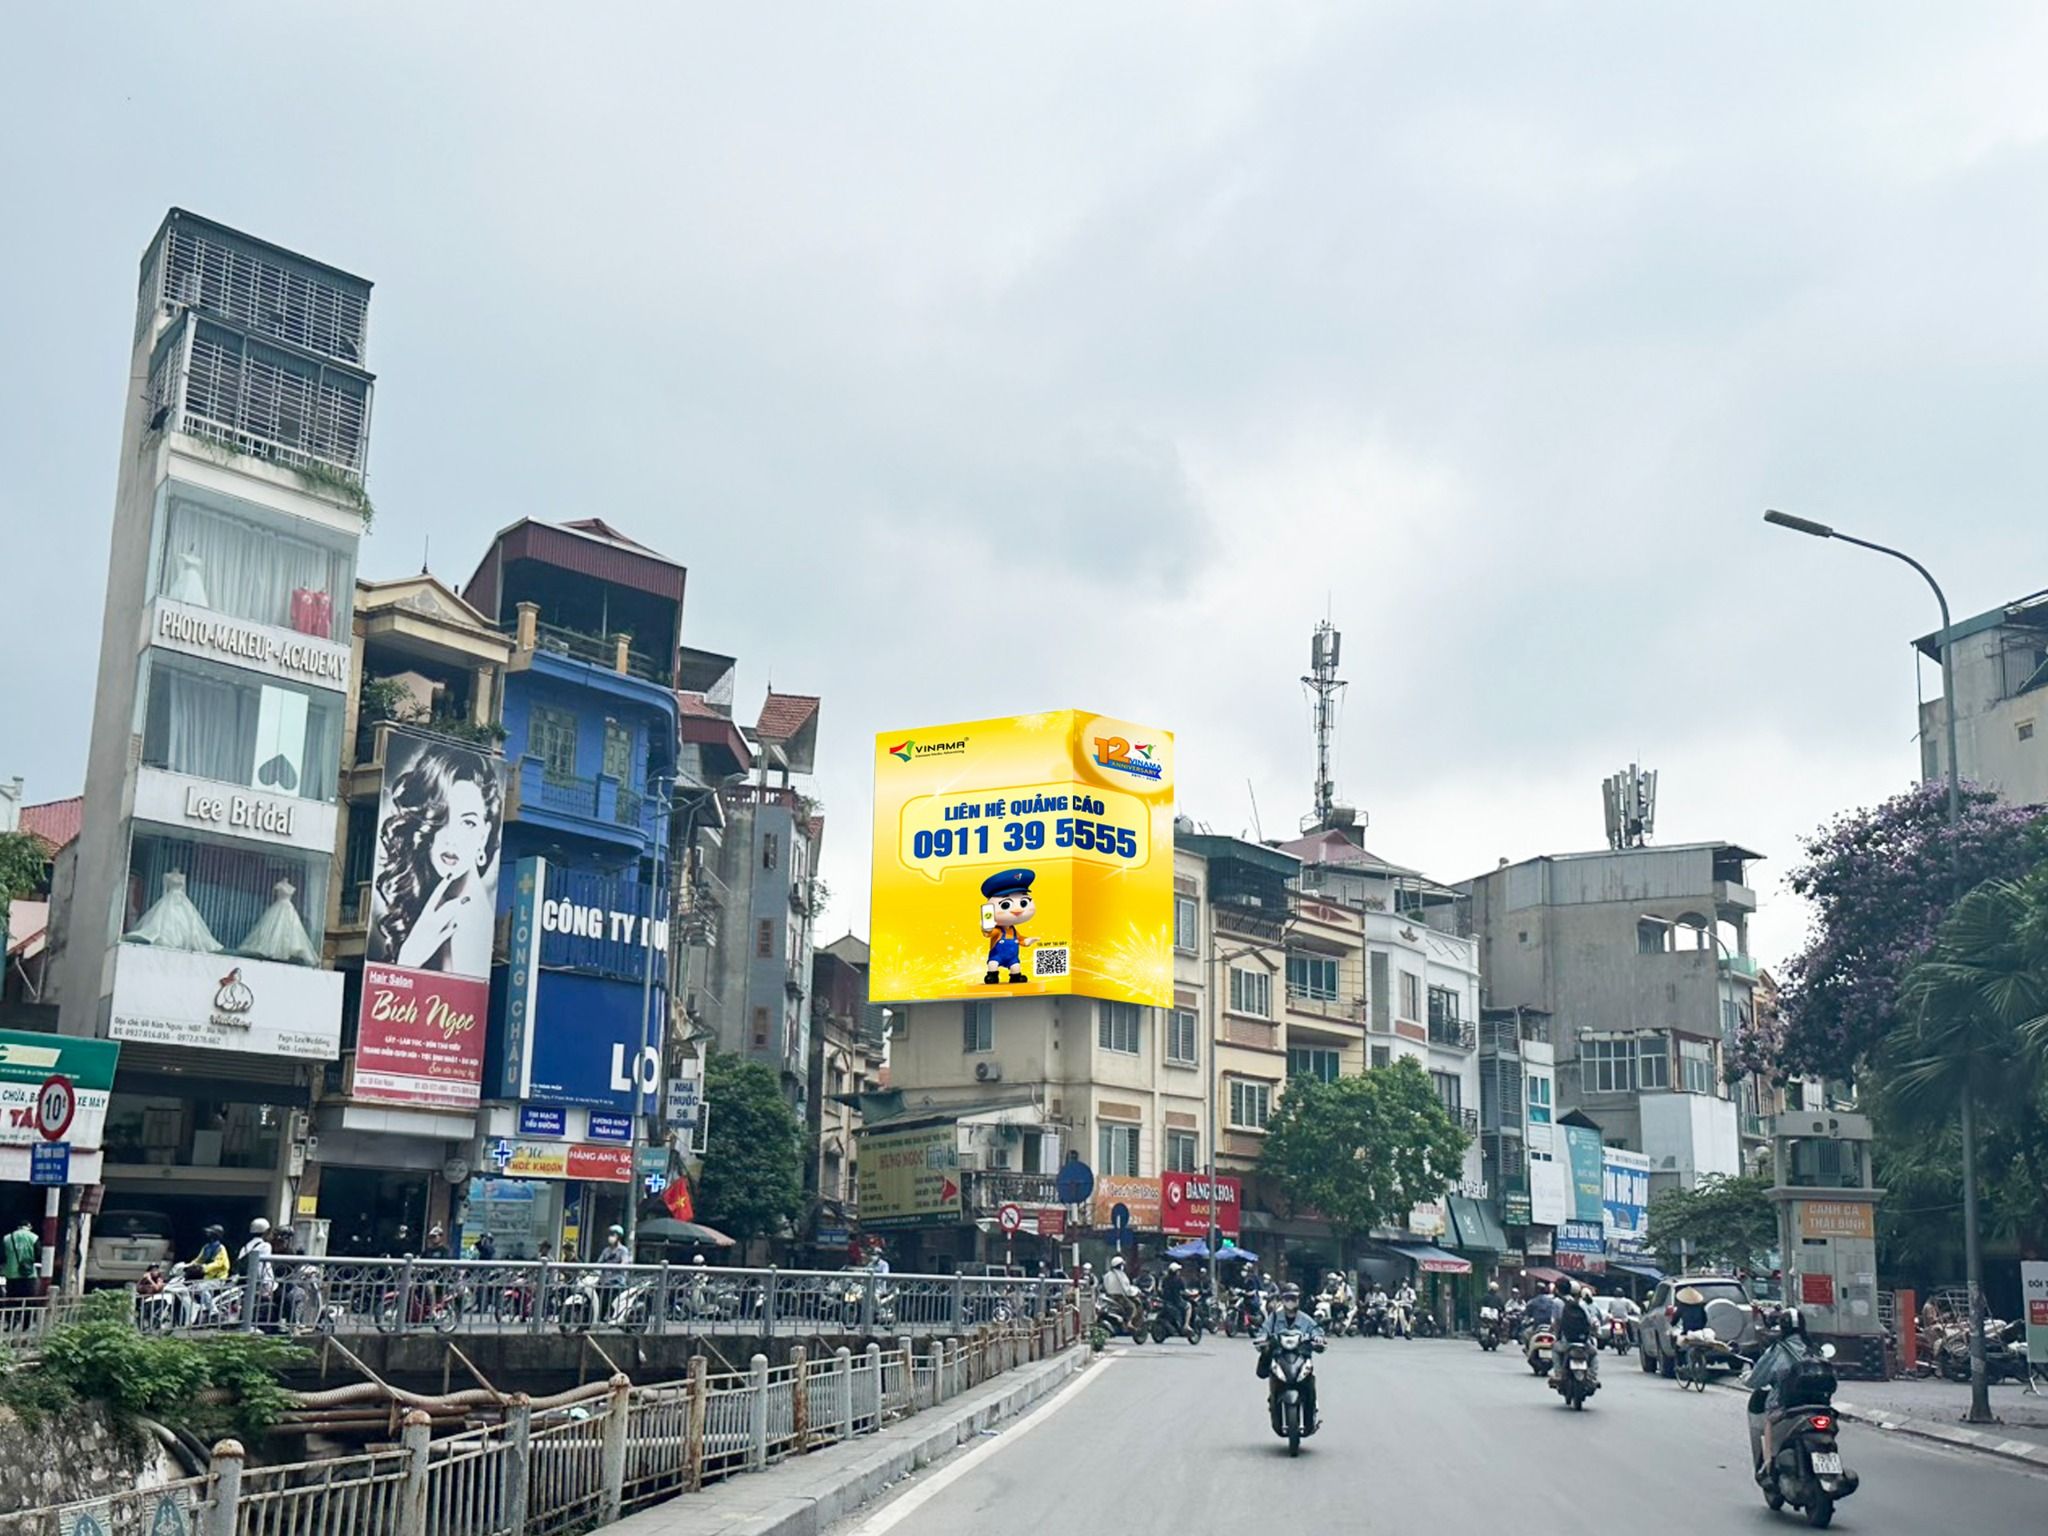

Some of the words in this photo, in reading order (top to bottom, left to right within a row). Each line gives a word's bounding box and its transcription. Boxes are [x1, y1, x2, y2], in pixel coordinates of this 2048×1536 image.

[915, 741, 965, 753] VINAMA
[1094, 736, 1130, 764] 12
[184, 786, 222, 822] Lee
[229, 795, 295, 835] Bridal
[944, 802, 981, 821] LIÊN
[984, 799, 1006, 819] HỆ
[1010, 793, 1069, 816] QUẢNG
[1072, 795, 1105, 816] CÁO
[913, 825, 989, 859] 0911
[1003, 820, 1045, 851] 39
[1055, 818, 1136, 858] 5555
[542, 897, 602, 940] CÔNG
[609, 911, 635, 944] TY
[513, 906, 527, 986] LONG
[369, 971, 388, 983] Hair
[389, 974, 413, 988] Salon
[371, 990, 418, 1024] Bích
[425, 995, 475, 1039] Ngọc
[507, 1001, 523, 1085] CHÂU
[89, 1096, 106, 1108] MÁY
